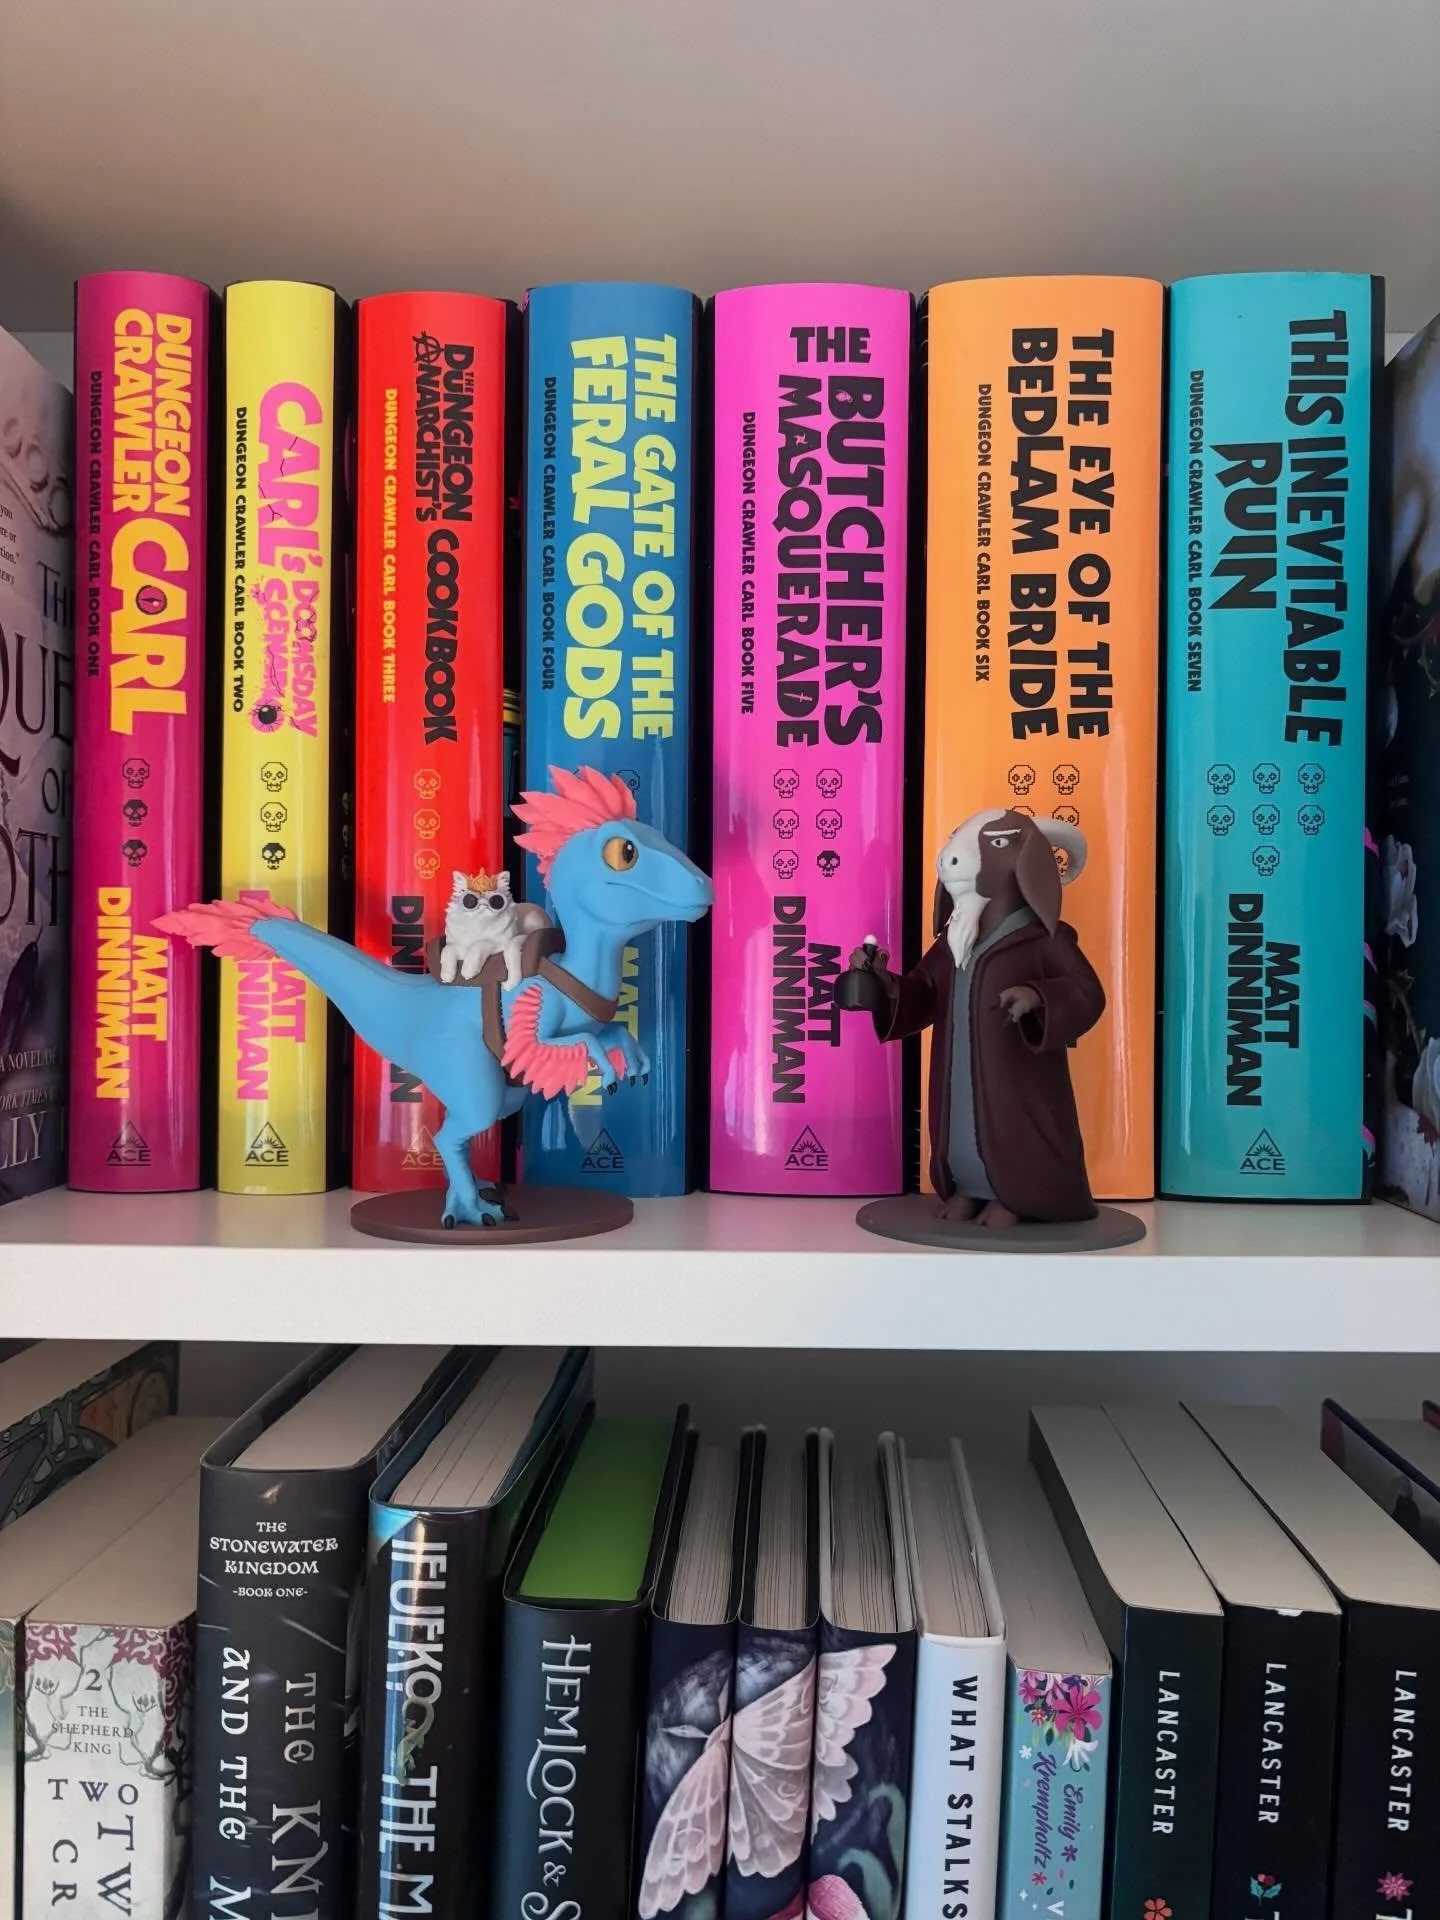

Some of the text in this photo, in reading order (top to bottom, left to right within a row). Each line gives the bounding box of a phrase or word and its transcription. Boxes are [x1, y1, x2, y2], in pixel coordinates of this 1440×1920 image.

[112, 308, 154, 513] CRAWLER
[154, 312, 192, 516] DUNGEON
[464, 371, 475, 393] THE
[790, 326, 871, 363] THE
[442, 344, 474, 522] DUNGEON
[87, 371, 102, 678] DUNGEON CRAWLER CARL BOOK ONE
[233, 407, 247, 713] DUNGEON CRAWLER CARL BOOK TWO
[382, 388, 398, 703] DUNGEON CRAWLER CARL BOOK THREE
[541, 376, 557, 690] DUNGEON CRAWLER CARL BOOK FOUR
[563, 335, 630, 740] FERAL GODS
[632, 333, 677, 741] THE GATE OF THE
[741, 411, 756, 714] DUNGEON CRAWLER CARL BOOK FIVE
[772, 374, 822, 748] MASQUERADE
[824, 375, 885, 746] BUTCHER'S
[975, 384, 992, 682] DUNGEON CRAWLER CARL BOOK SIX
[1007, 327, 1064, 741] BEDLAM BRIDE
[1066, 327, 1115, 740] THE EYE OF THE
[1187, 370, 1204, 693] DUNGEON CRAWLER CARL BOOK SEVEN
[1207, 441, 1283, 610] RUIN
[1283, 309, 1349, 747] THIS INEVITABLE
[110, 517, 190, 736] CARL
[423, 529, 460, 744] COOKBOOK
[96, 887, 132, 1100] DINNIMAN
[131, 934, 170, 1041] MATT
[772, 895, 806, 1104] DINNIMAN
[808, 943, 841, 1047] MATT
[1226, 893, 1264, 1106] DINNIMAN
[1264, 941, 1300, 1048] MATT
[106, 1148, 151, 1162] ACE
[245, 1148, 289, 1162] ACE
[402, 1153, 443, 1166] ACE
[581, 1156, 624, 1169] ACE
[785, 1153, 828, 1167] ACE
[1240, 1157, 1286, 1170] ACE
[224, 1560, 320, 1576] KINGDOM
[256, 1521, 287, 1533] THE
[51, 1722, 134, 1738] SHEPHERD
[73, 1742, 112, 1755] KING
[76, 1705, 110, 1718] THE
[85, 1669, 103, 1691] 2
[284, 1672, 318, 1764] THE
[526, 1634, 592, 1855] HEMLOCK
[1152, 1670, 1181, 1834] LANCASTER
[1258, 1662, 1287, 1824] LANCASTER
[1387, 1669, 1417, 1832] LANCASTER
[47, 1778, 139, 1806] TWO
[219, 1755, 248, 1841] THE
[379, 1765, 438, 1853] THE
[942, 1674, 978, 1920] WHAT STALKS
[1058, 1783, 1084, 1841] Emily
[542, 1861, 567, 1888] &
